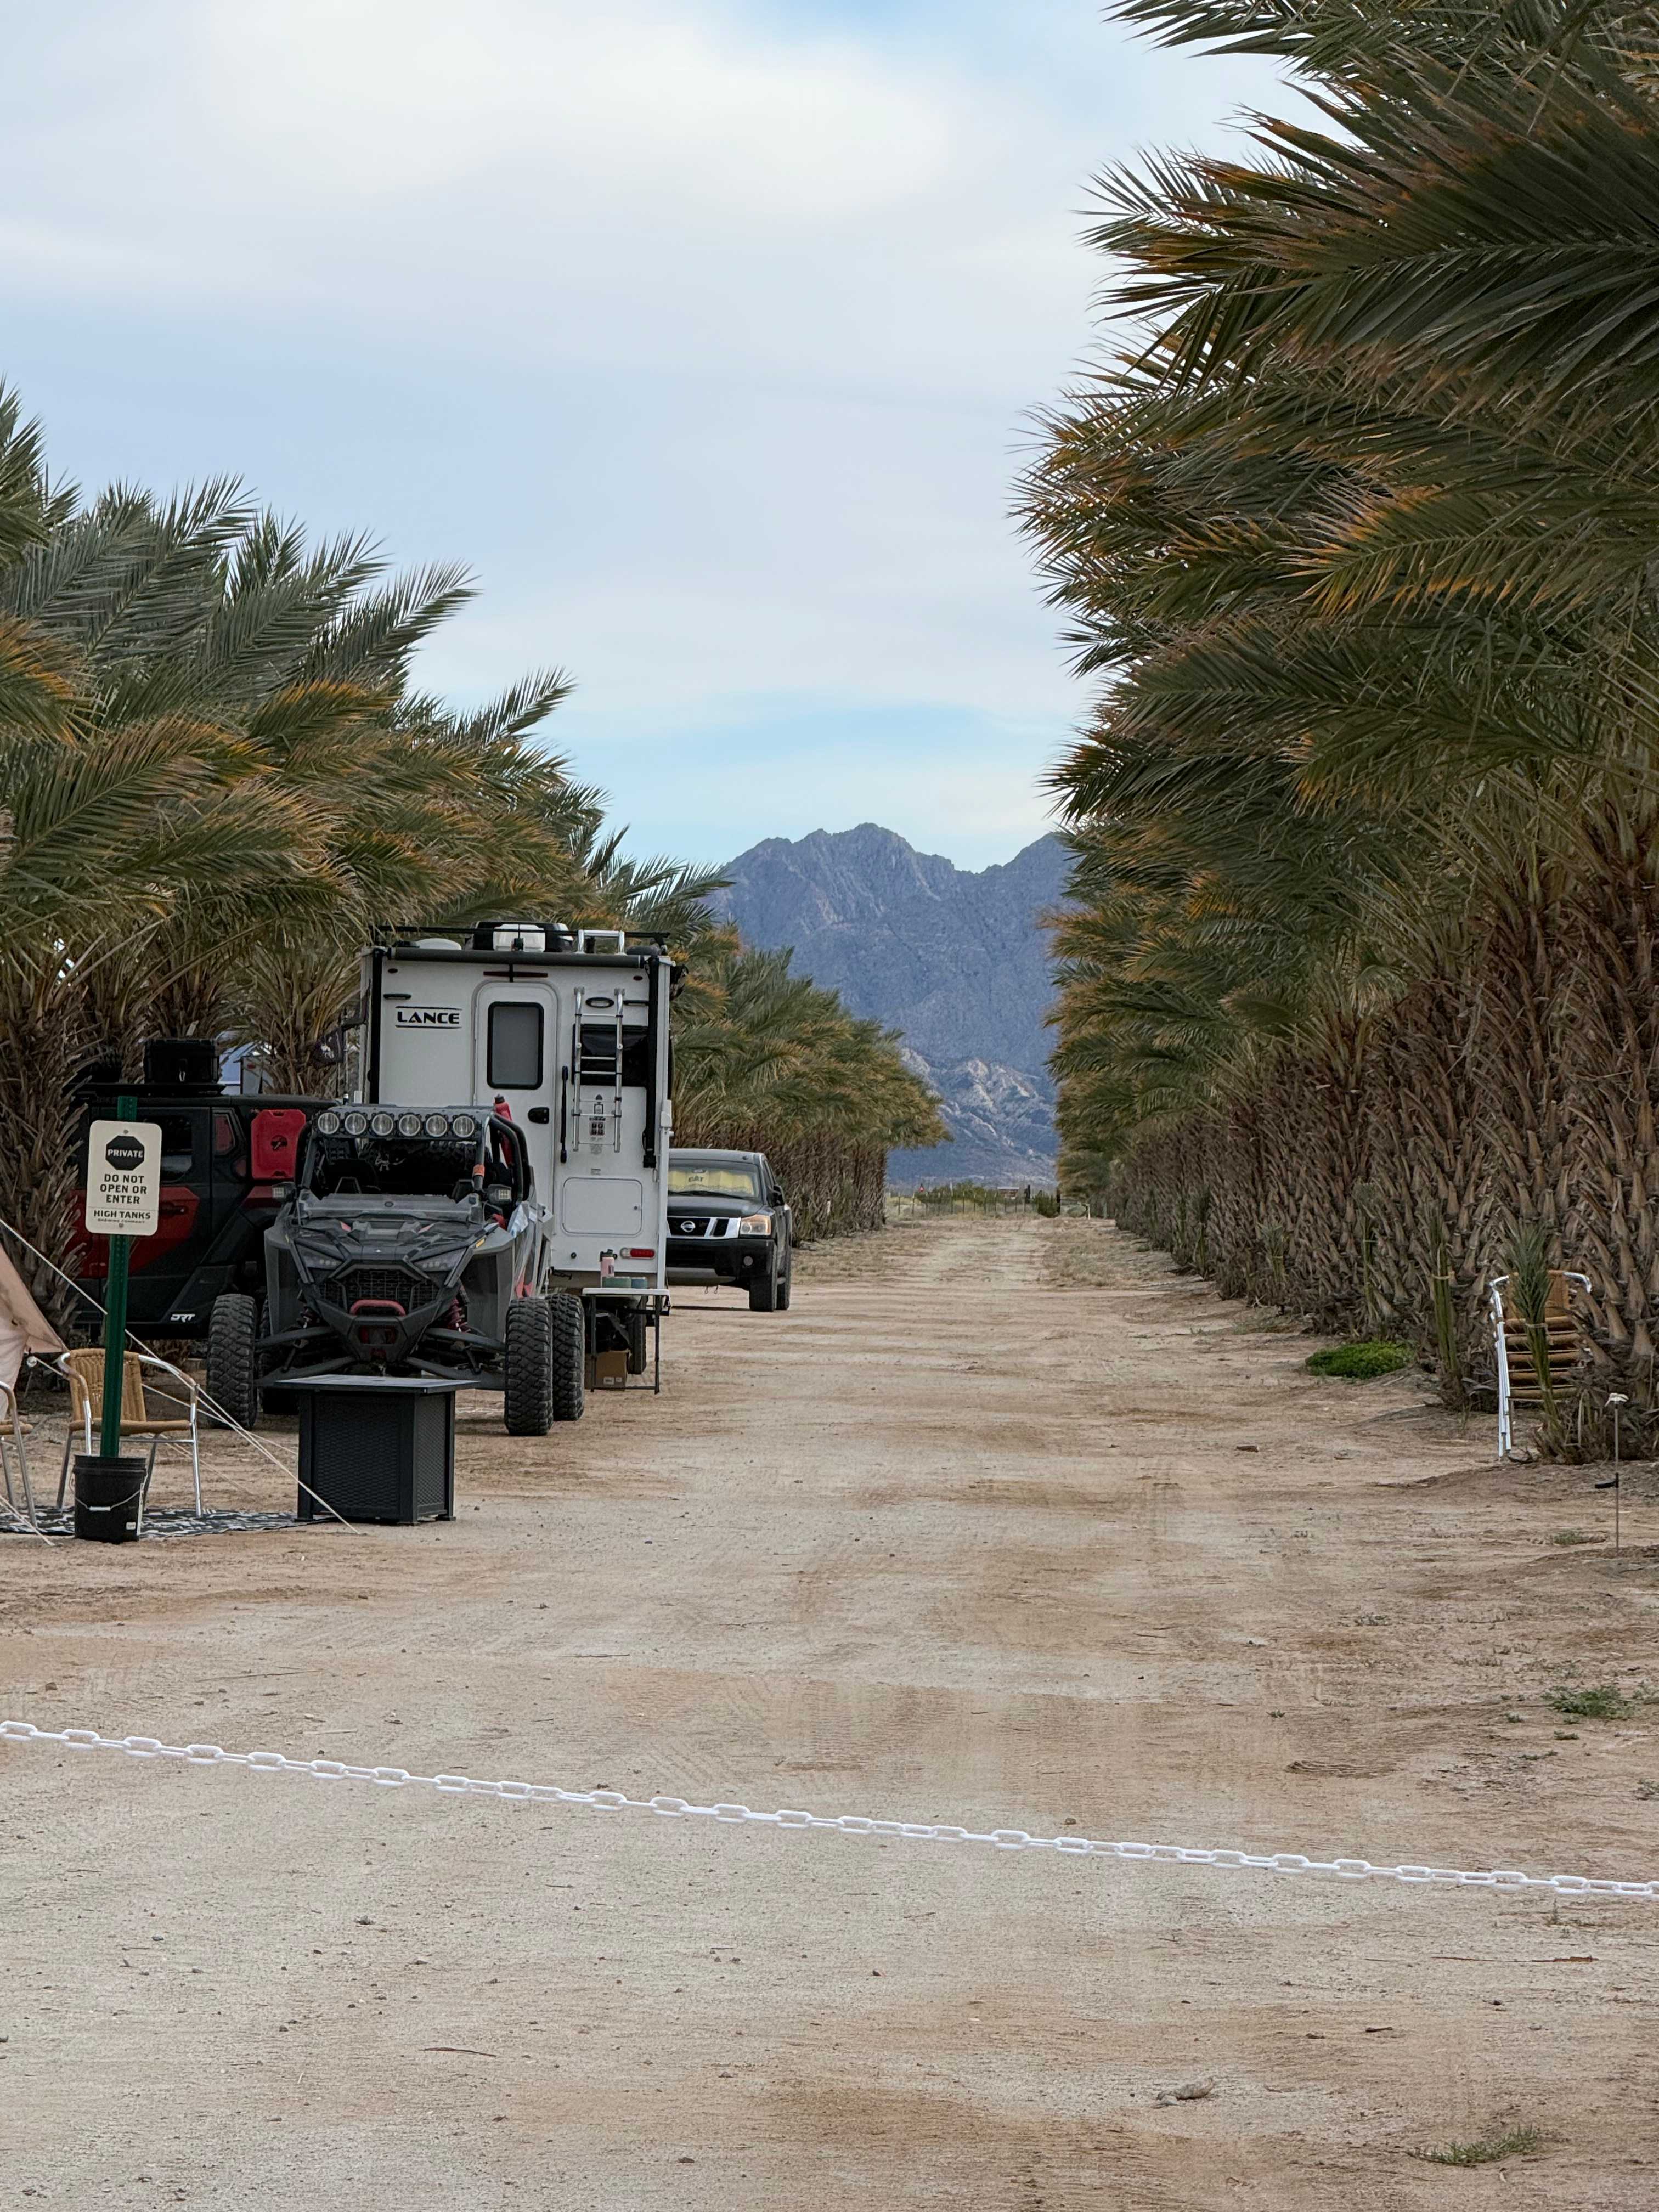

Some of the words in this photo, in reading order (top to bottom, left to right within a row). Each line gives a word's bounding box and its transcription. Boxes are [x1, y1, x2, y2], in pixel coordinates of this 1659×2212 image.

[397, 1011, 460, 1024] LANCE
[108, 1149, 143, 1158] PRIVATE
[104, 1174, 119, 1183] DO
[123, 1175, 145, 1183] NOT
[100, 1184, 128, 1193] OPEN
[132, 1186, 147, 1194] OR
[106, 1194, 140, 1204] ENTER
[93, 1210, 117, 1218] HIGH
[119, 1211, 151, 1220] TANKS
